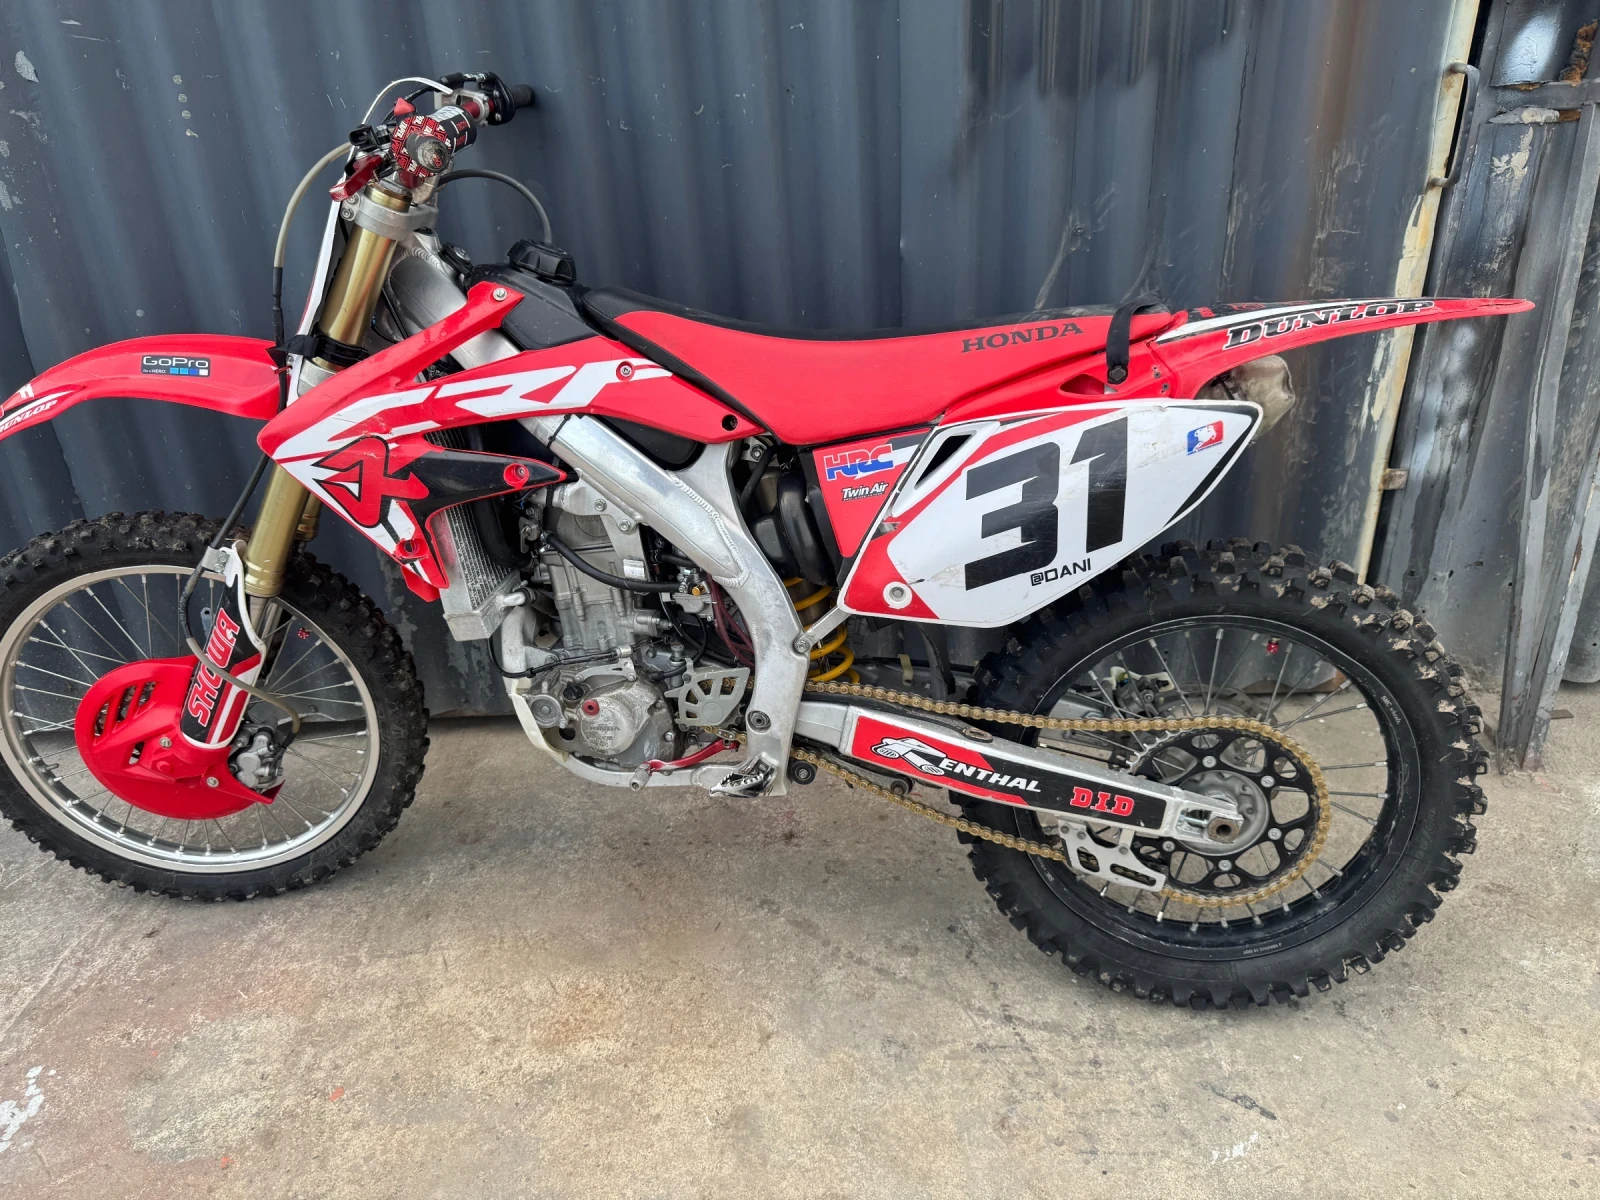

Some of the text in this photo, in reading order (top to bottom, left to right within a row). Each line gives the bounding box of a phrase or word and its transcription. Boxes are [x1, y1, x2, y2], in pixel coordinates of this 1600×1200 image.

[961, 322, 1083, 353] HONDA
[1223, 300, 1435, 350] DUNLOP
[143, 356, 209, 368] GoPro
[823, 443, 895, 482] HRC
[842, 485, 870, 499] Twin
[870, 481, 889, 496] Air
[965, 416, 1128, 591] 31
[1030, 557, 1092, 587] @DANI
[187, 607, 240, 727] SHOWA
[1070, 786, 1135, 817] D.I.D
